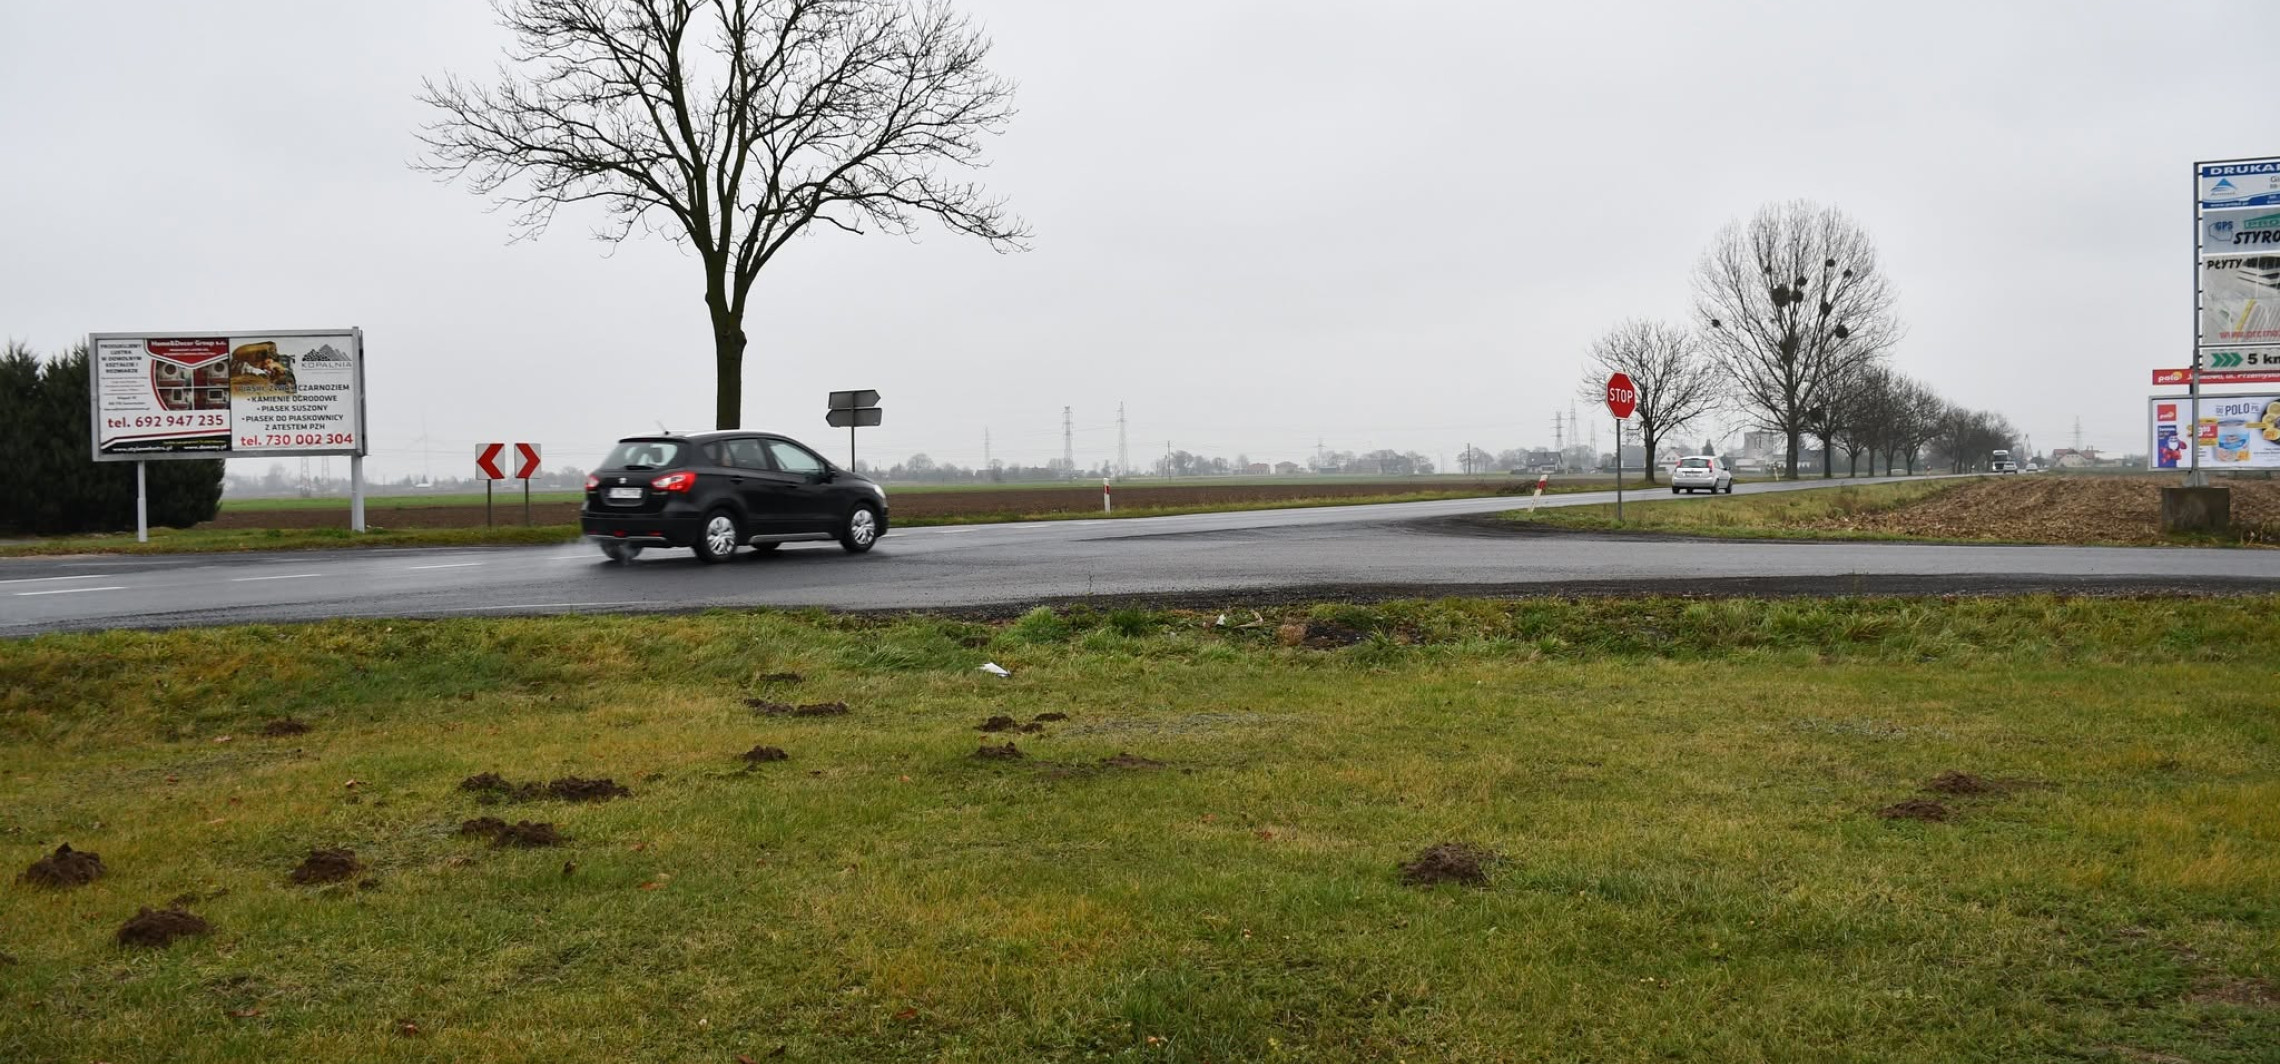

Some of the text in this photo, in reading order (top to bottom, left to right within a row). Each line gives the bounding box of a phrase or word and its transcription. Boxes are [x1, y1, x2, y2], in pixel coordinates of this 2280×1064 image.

[2206, 259, 2242, 270] PŁYTY
[2247, 353, 2258, 364] 5
[298, 384, 350, 392] CZARNOZIEM
[1609, 388, 1634, 403] STOP
[2225, 403, 2250, 415] POLO
[108, 415, 224, 428] tel. 692 947 235
[240, 433, 354, 446] tel. 730 002 304
